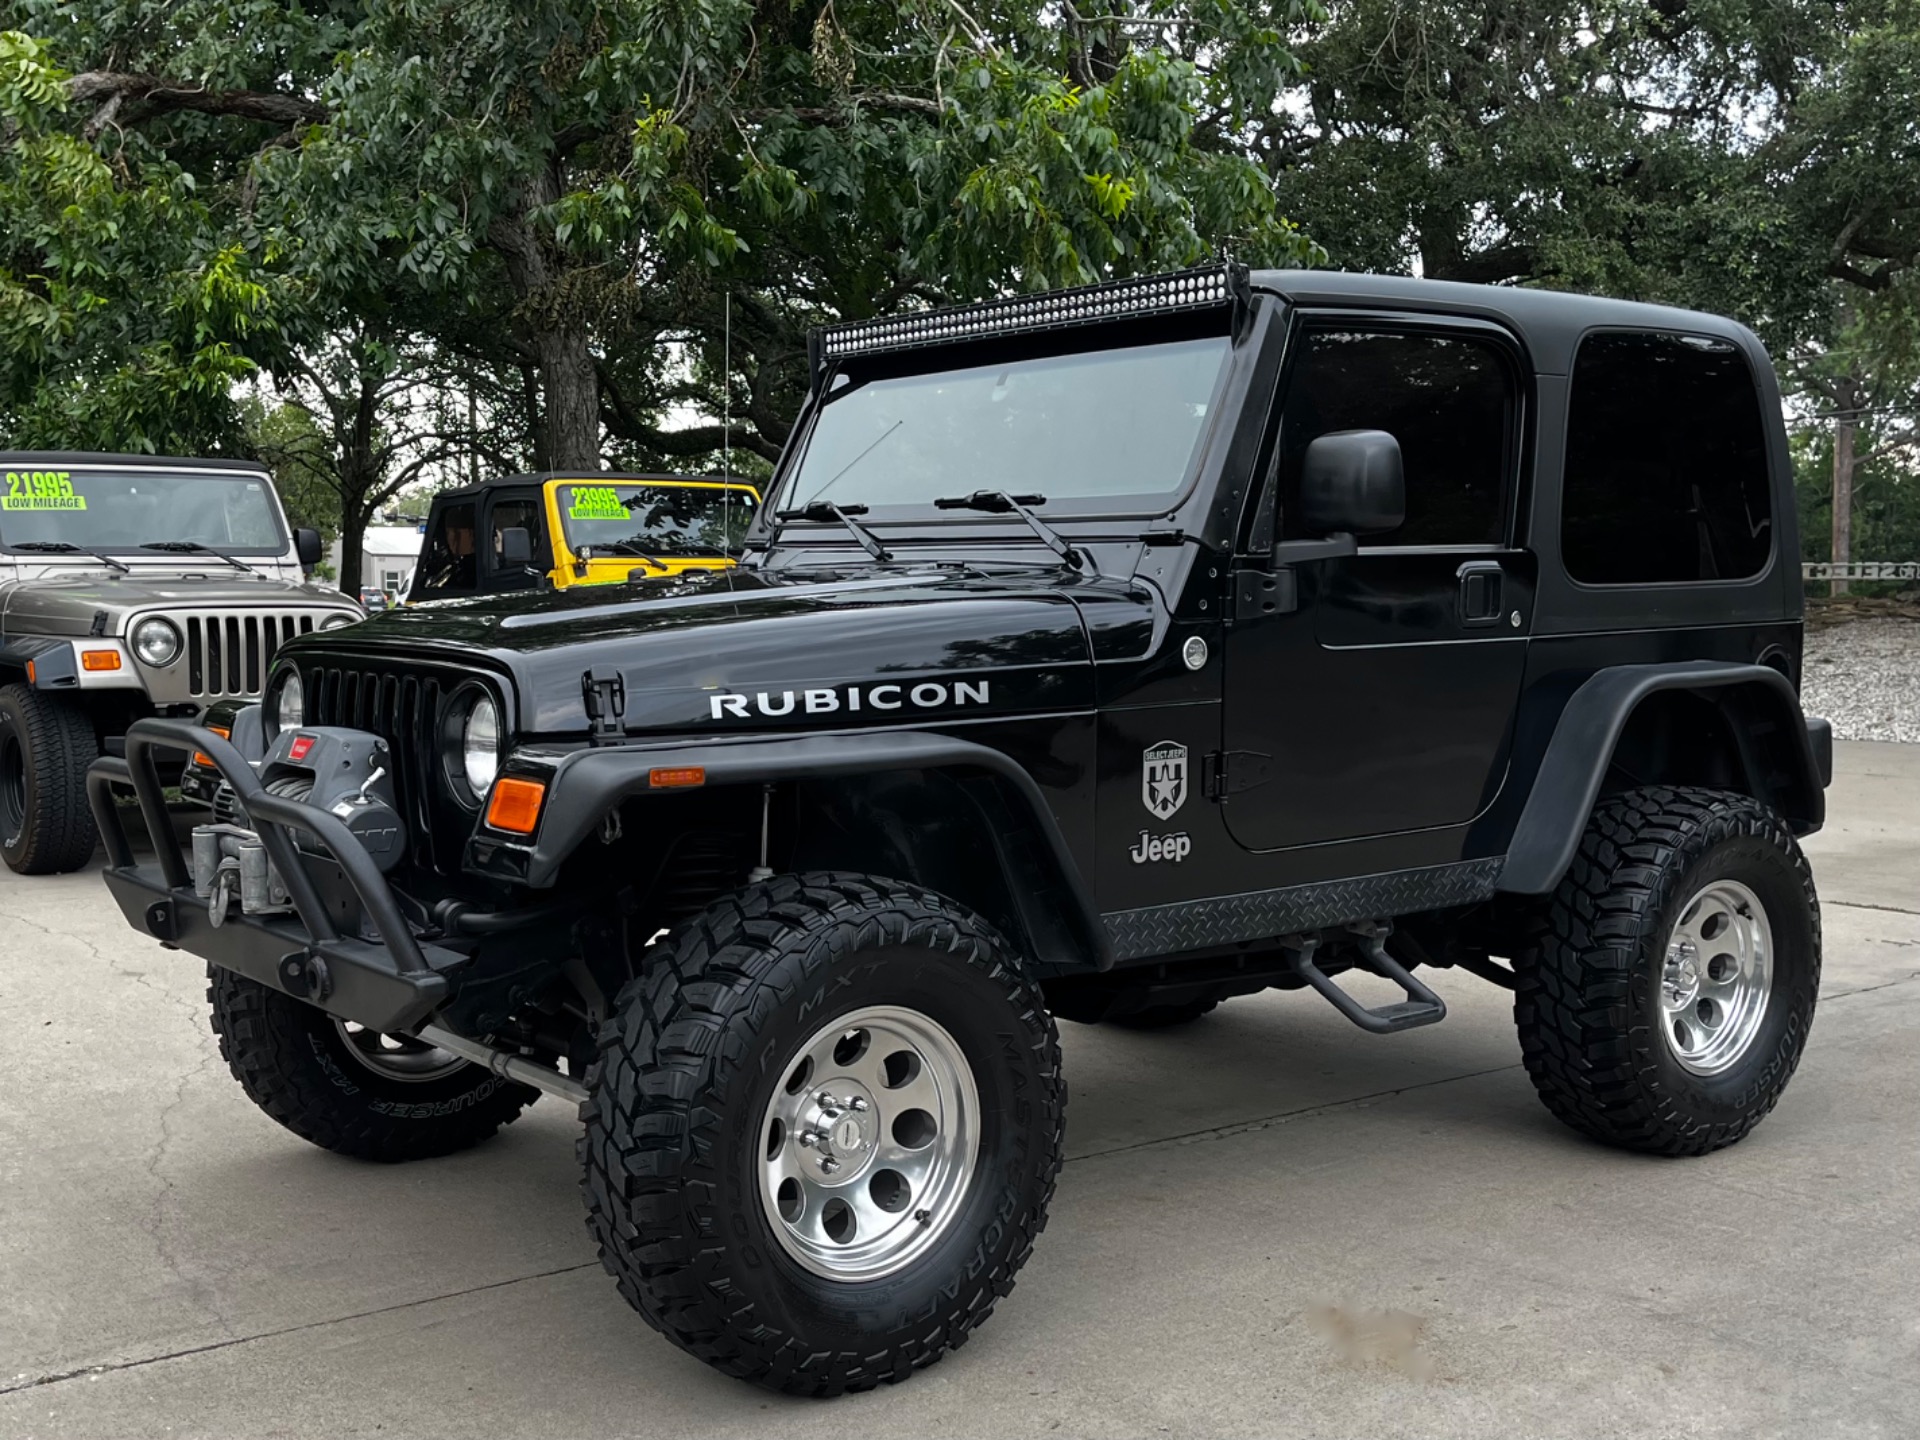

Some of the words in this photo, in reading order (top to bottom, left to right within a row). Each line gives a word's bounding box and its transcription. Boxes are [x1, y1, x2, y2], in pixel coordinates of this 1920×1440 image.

[6, 472, 73, 497] 21995
[7, 498, 31, 508] LOW
[33, 497, 80, 508] MILEAGE
[570, 487, 621, 508] 23995
[573, 508, 590, 517] LOW
[591, 508, 625, 517] MILEAGE
[709, 679, 990, 720] RUBICON
[1145, 750, 1168, 761] SELECT
[1168, 748, 1186, 759] JEEPS
[1128, 829, 1191, 864] Jeep
[797, 959, 890, 1025] MXT
